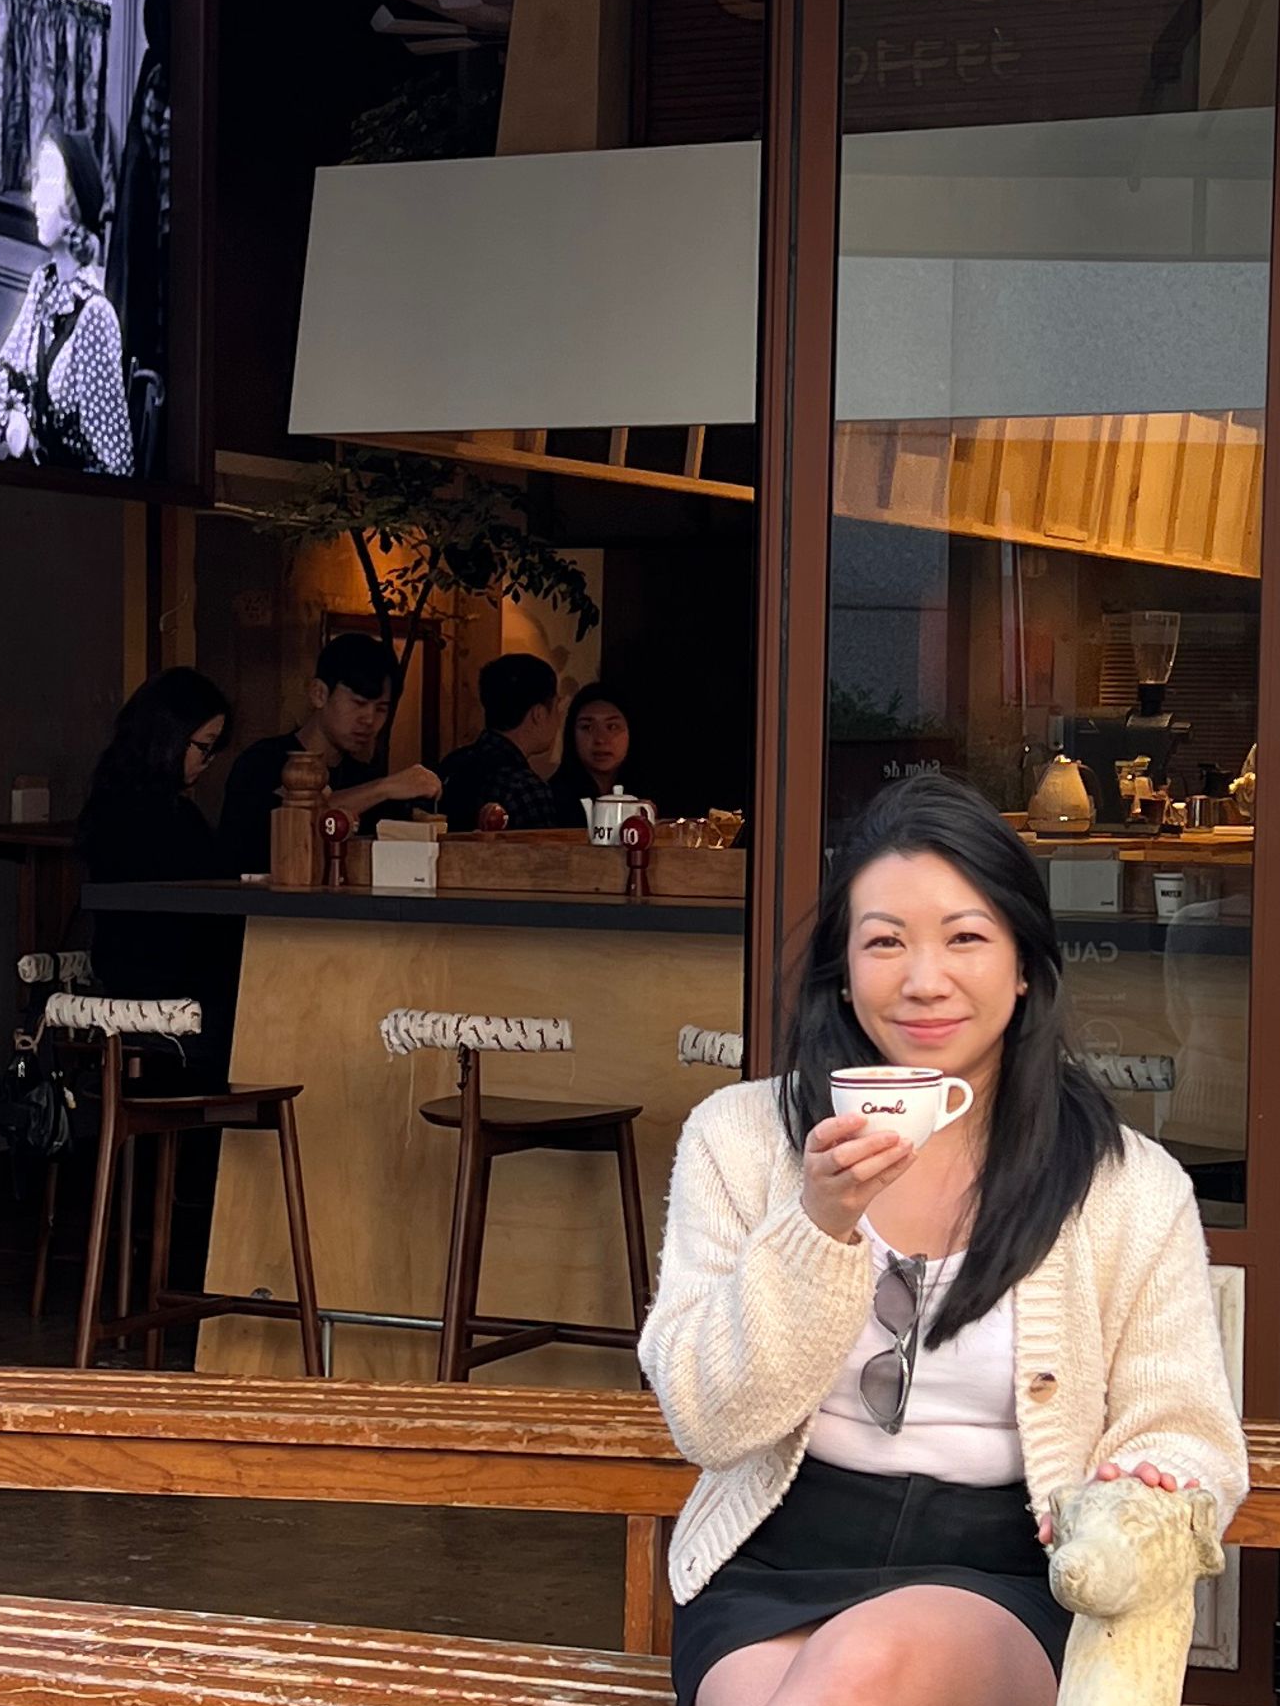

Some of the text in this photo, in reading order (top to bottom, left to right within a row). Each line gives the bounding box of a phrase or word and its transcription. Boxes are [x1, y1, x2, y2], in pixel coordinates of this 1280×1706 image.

[843, 36, 1022, 88] OFFEE
[324, 816, 336, 836] 9
[593, 826, 613, 842] POT
[622, 827, 639, 846] 10
[861, 1099, 907, 1116] Camel
